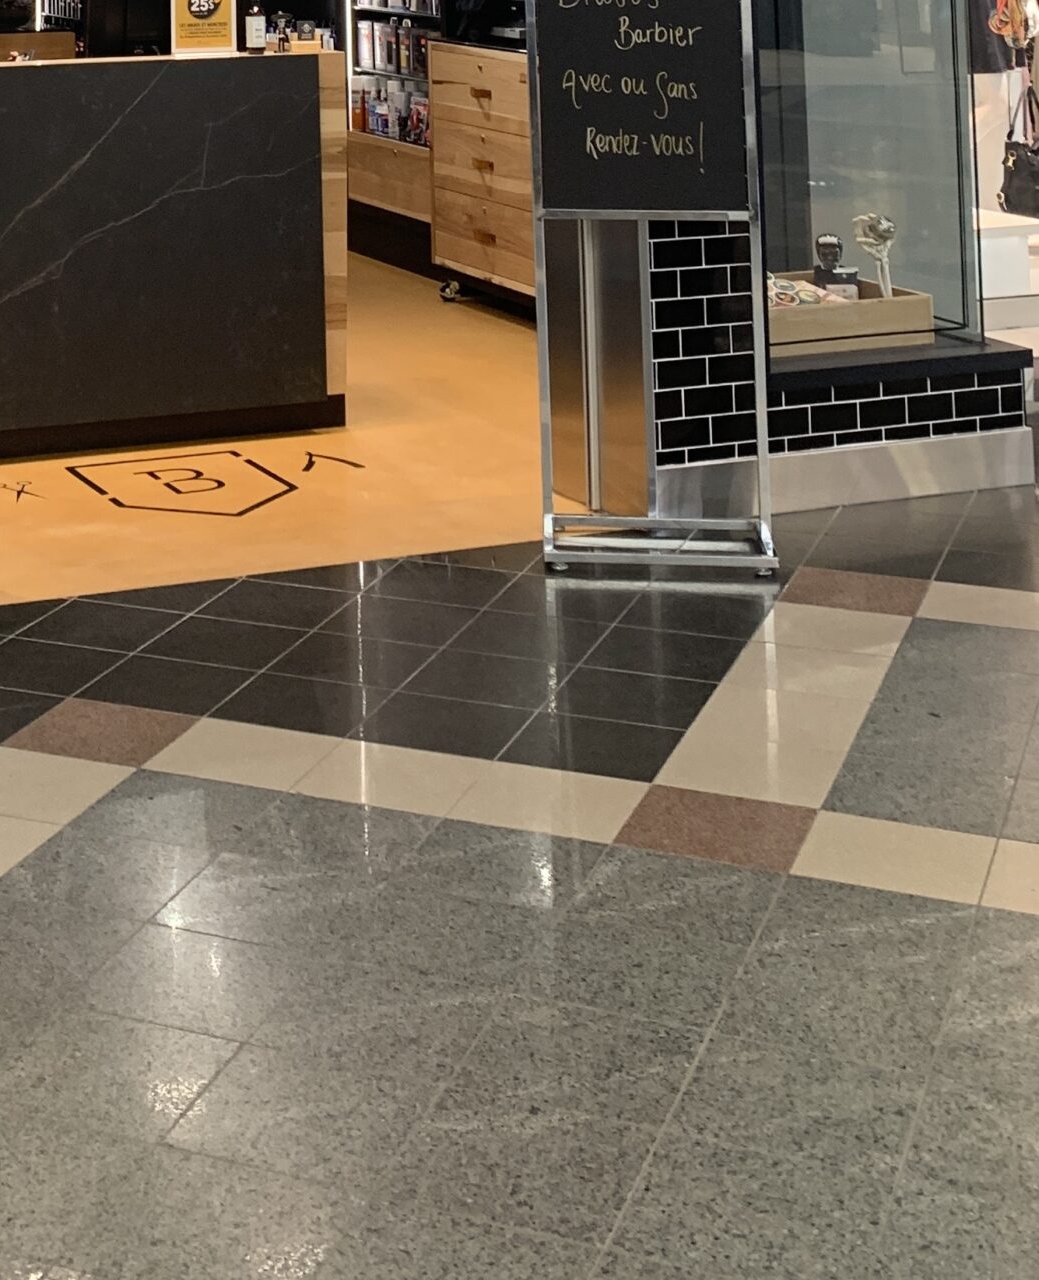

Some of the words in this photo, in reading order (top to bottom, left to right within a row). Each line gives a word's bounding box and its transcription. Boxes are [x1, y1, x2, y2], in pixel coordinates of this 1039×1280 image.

[614, 15, 703, 50] Barbier
[562, 69, 612, 110] Avec
[620, 76, 648, 95] ou
